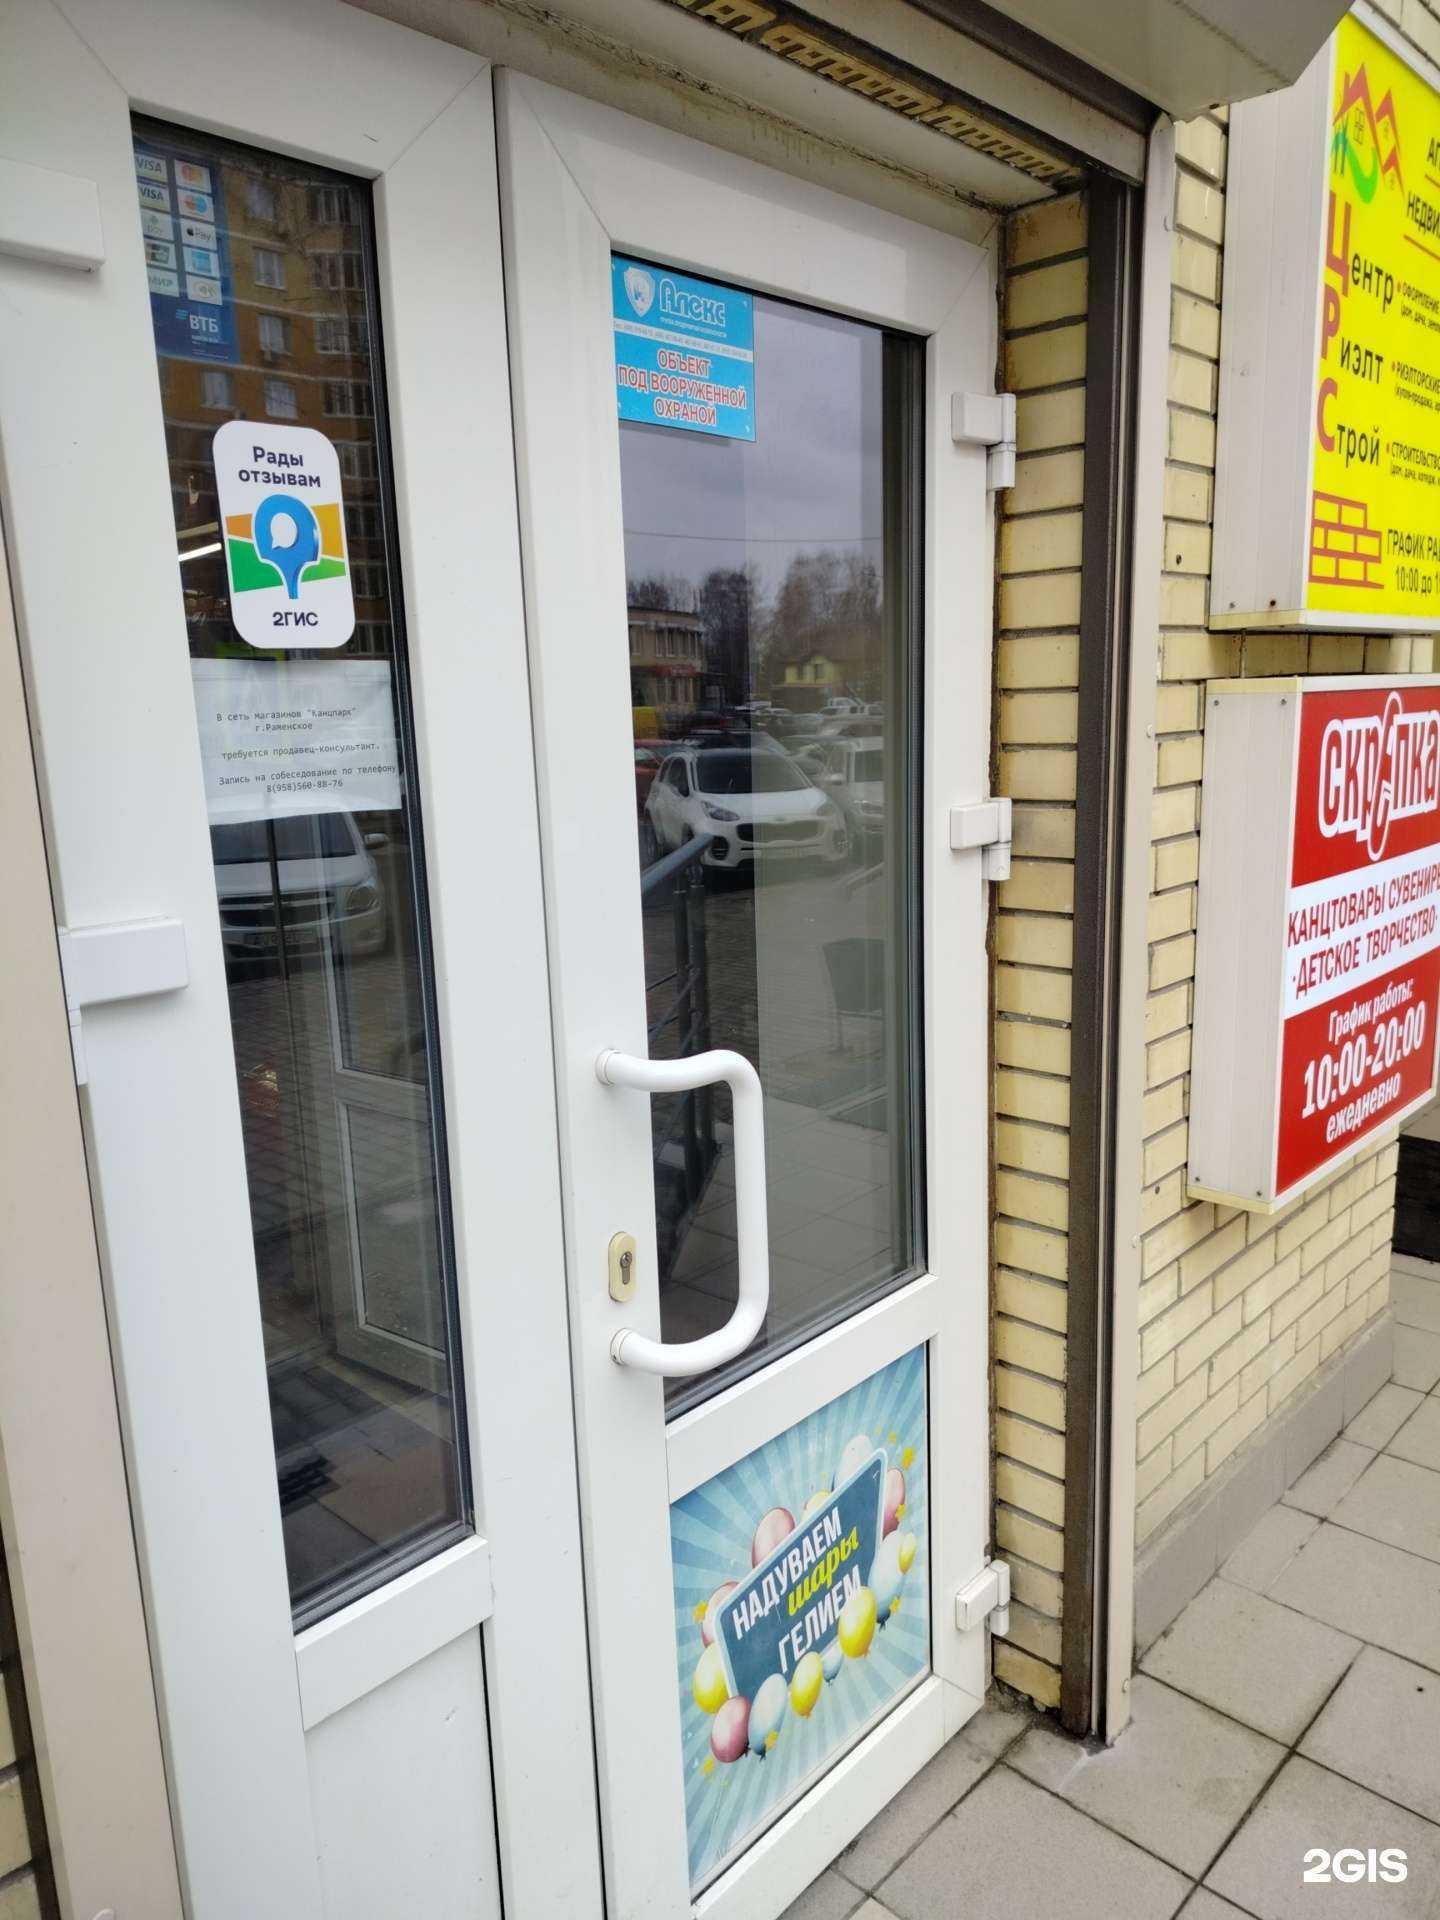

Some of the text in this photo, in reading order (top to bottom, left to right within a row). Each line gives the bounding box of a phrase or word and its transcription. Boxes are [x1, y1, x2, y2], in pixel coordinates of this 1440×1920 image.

[137, 158, 163, 172] VISA
[140, 186, 164, 200] VISA
[1326, 190, 1394, 313] Центр
[190, 314, 218, 332] ВТБ
[1321, 283, 1384, 384] Риэлт
[658, 350, 711, 378] ОБЪЕКТ
[618, 364, 747, 409] ПОД ВООРУЖЕННОЙ
[654, 397, 717, 426] ОХРАНОЙ
[1317, 377, 1380, 468] Строй
[253, 446, 304, 468] Рады
[239, 469, 321, 488] отзывам
[1387, 528, 1425, 560] ГРАФИК
[1396, 567, 1419, 593] 10:00
[1421, 575, 1432, 597] до
[273, 612, 319, 627] 2ГИС
[216, 713, 223, 722] В
[227, 713, 250, 722] сеть
[254, 711, 302, 720] магазинов
[255, 722, 313, 733] г.Раменское
[222, 749, 269, 761] требуется
[219, 764, 396, 786] Запись на собеседование по телефону
[1287, 882, 1386, 948] КАНЦТОВАРЫ
[1328, 978, 1414, 1045] График работы:
[1302, 1000, 1426, 1119] 10:00-20:00
[1326, 1072, 1401, 1143] ежедневно
[732, 1506, 842, 1640] НАДУВАЕМ
[788, 1526, 860, 1616] шары
[778, 1564, 862, 1674] ГЕЛИЕМ
